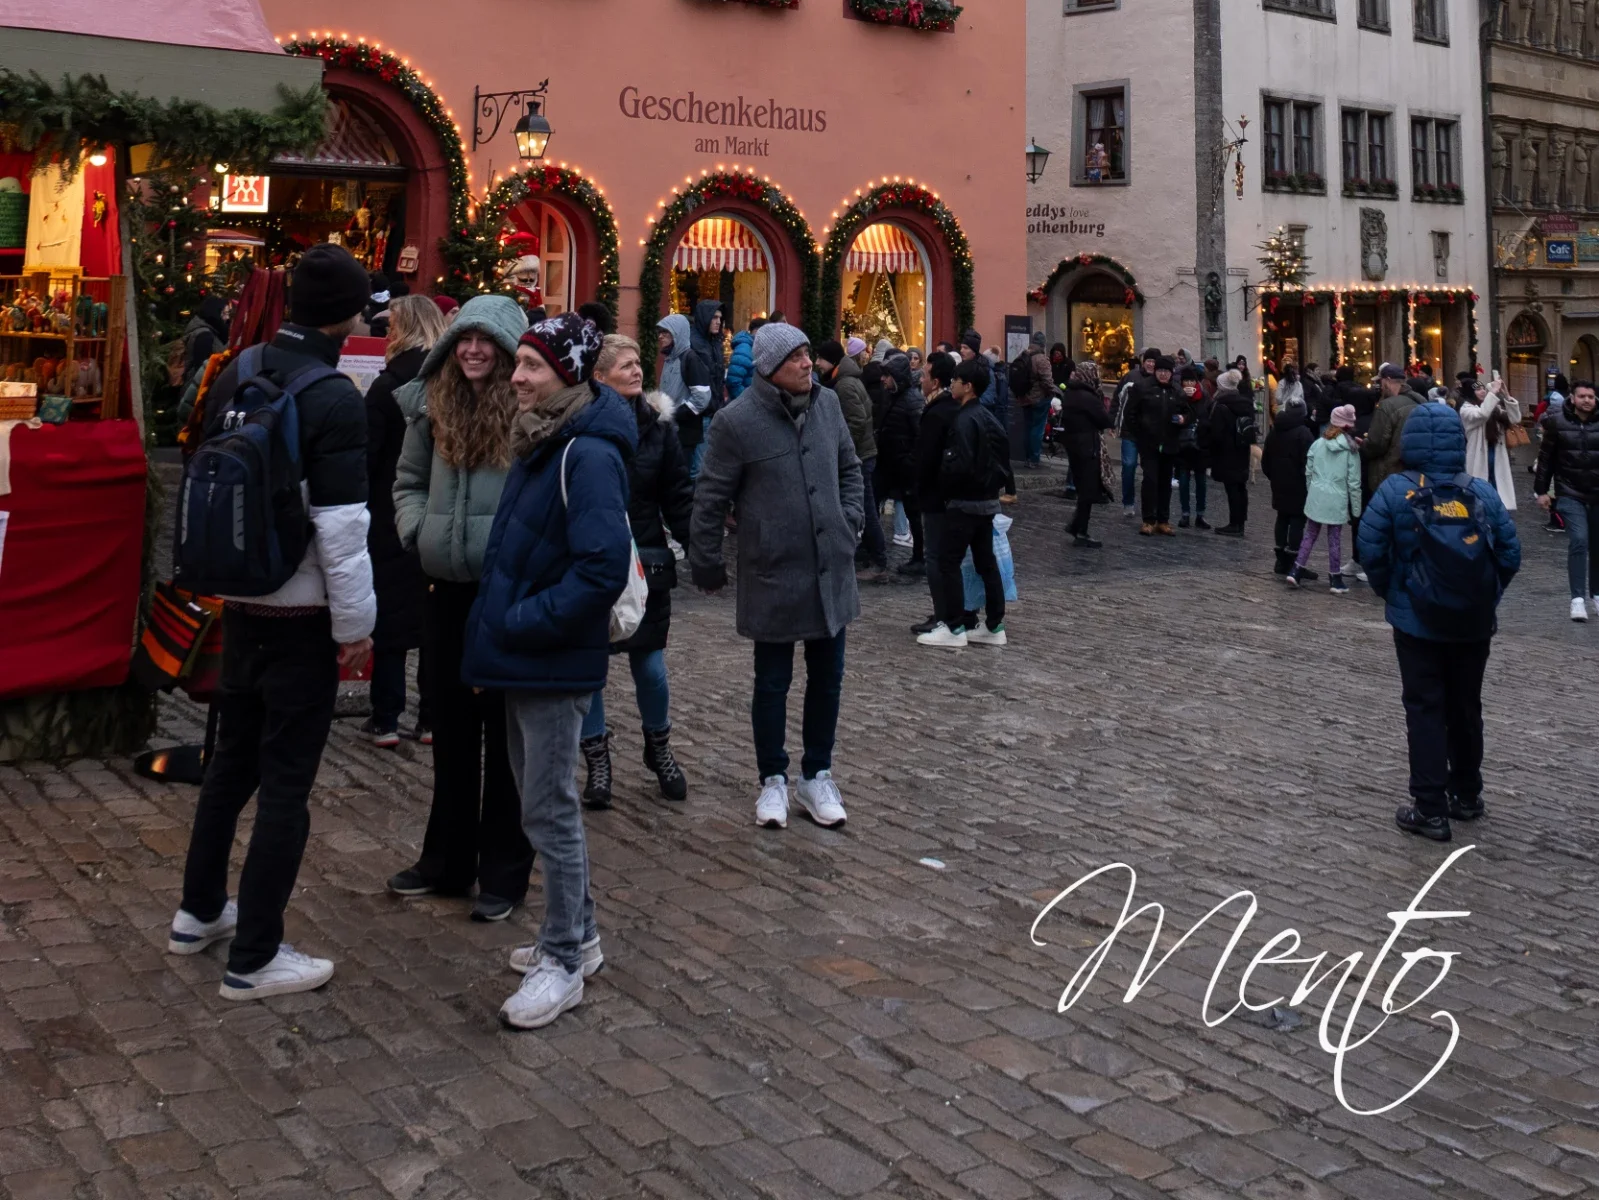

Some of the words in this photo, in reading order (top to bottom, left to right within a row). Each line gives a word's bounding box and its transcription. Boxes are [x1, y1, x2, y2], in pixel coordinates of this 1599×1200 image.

[618, 85, 827, 133] Geschenkehaus
[694, 137, 720, 154] am
[725, 135, 770, 157] Markt
[1026, 203, 1066, 221] eddys
[1069, 206, 1090, 218] love
[1027, 220, 1106, 238] othenburg
